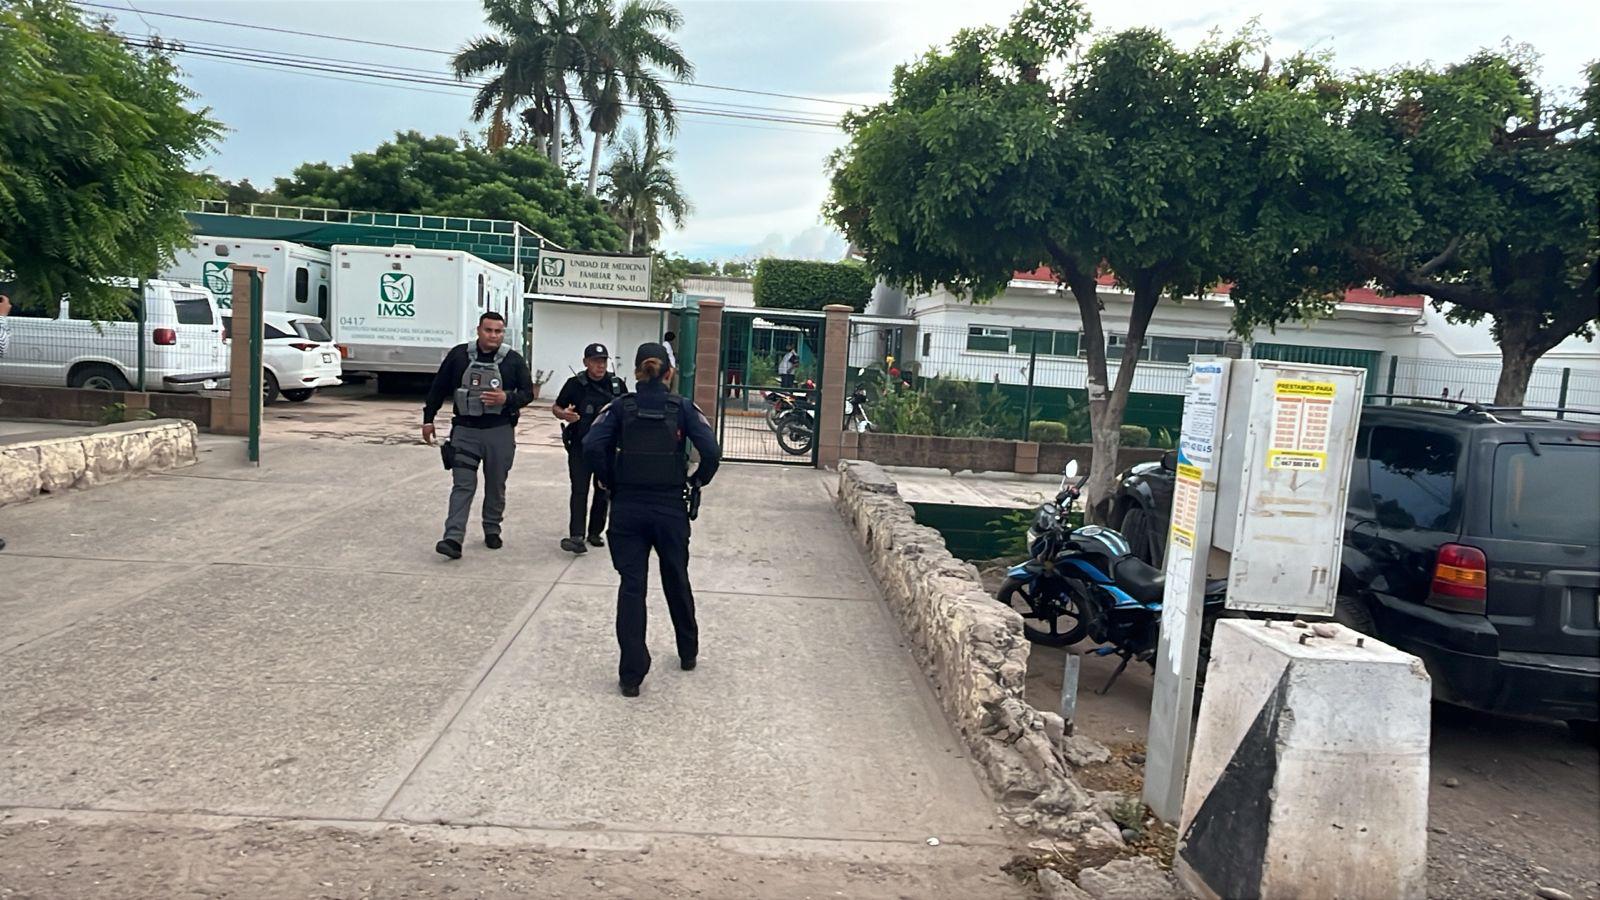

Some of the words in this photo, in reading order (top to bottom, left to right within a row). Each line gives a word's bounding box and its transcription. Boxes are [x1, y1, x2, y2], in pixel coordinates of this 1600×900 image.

[570, 259, 598, 269] UNIDAD
[600, 261, 609, 269] DE
[612, 262, 646, 271] MEDICINA
[579, 271, 611, 280] FAMILIAR
[540, 277, 565, 288] IMSS
[568, 280, 588, 289] VILLA
[589, 282, 614, 291] JUAREZ
[617, 284, 646, 293] SINALOA
[377, 303, 416, 317] IMSS
[339, 317, 366, 326] 0417
[1276, 383, 1314, 391] PRESTAMOS
